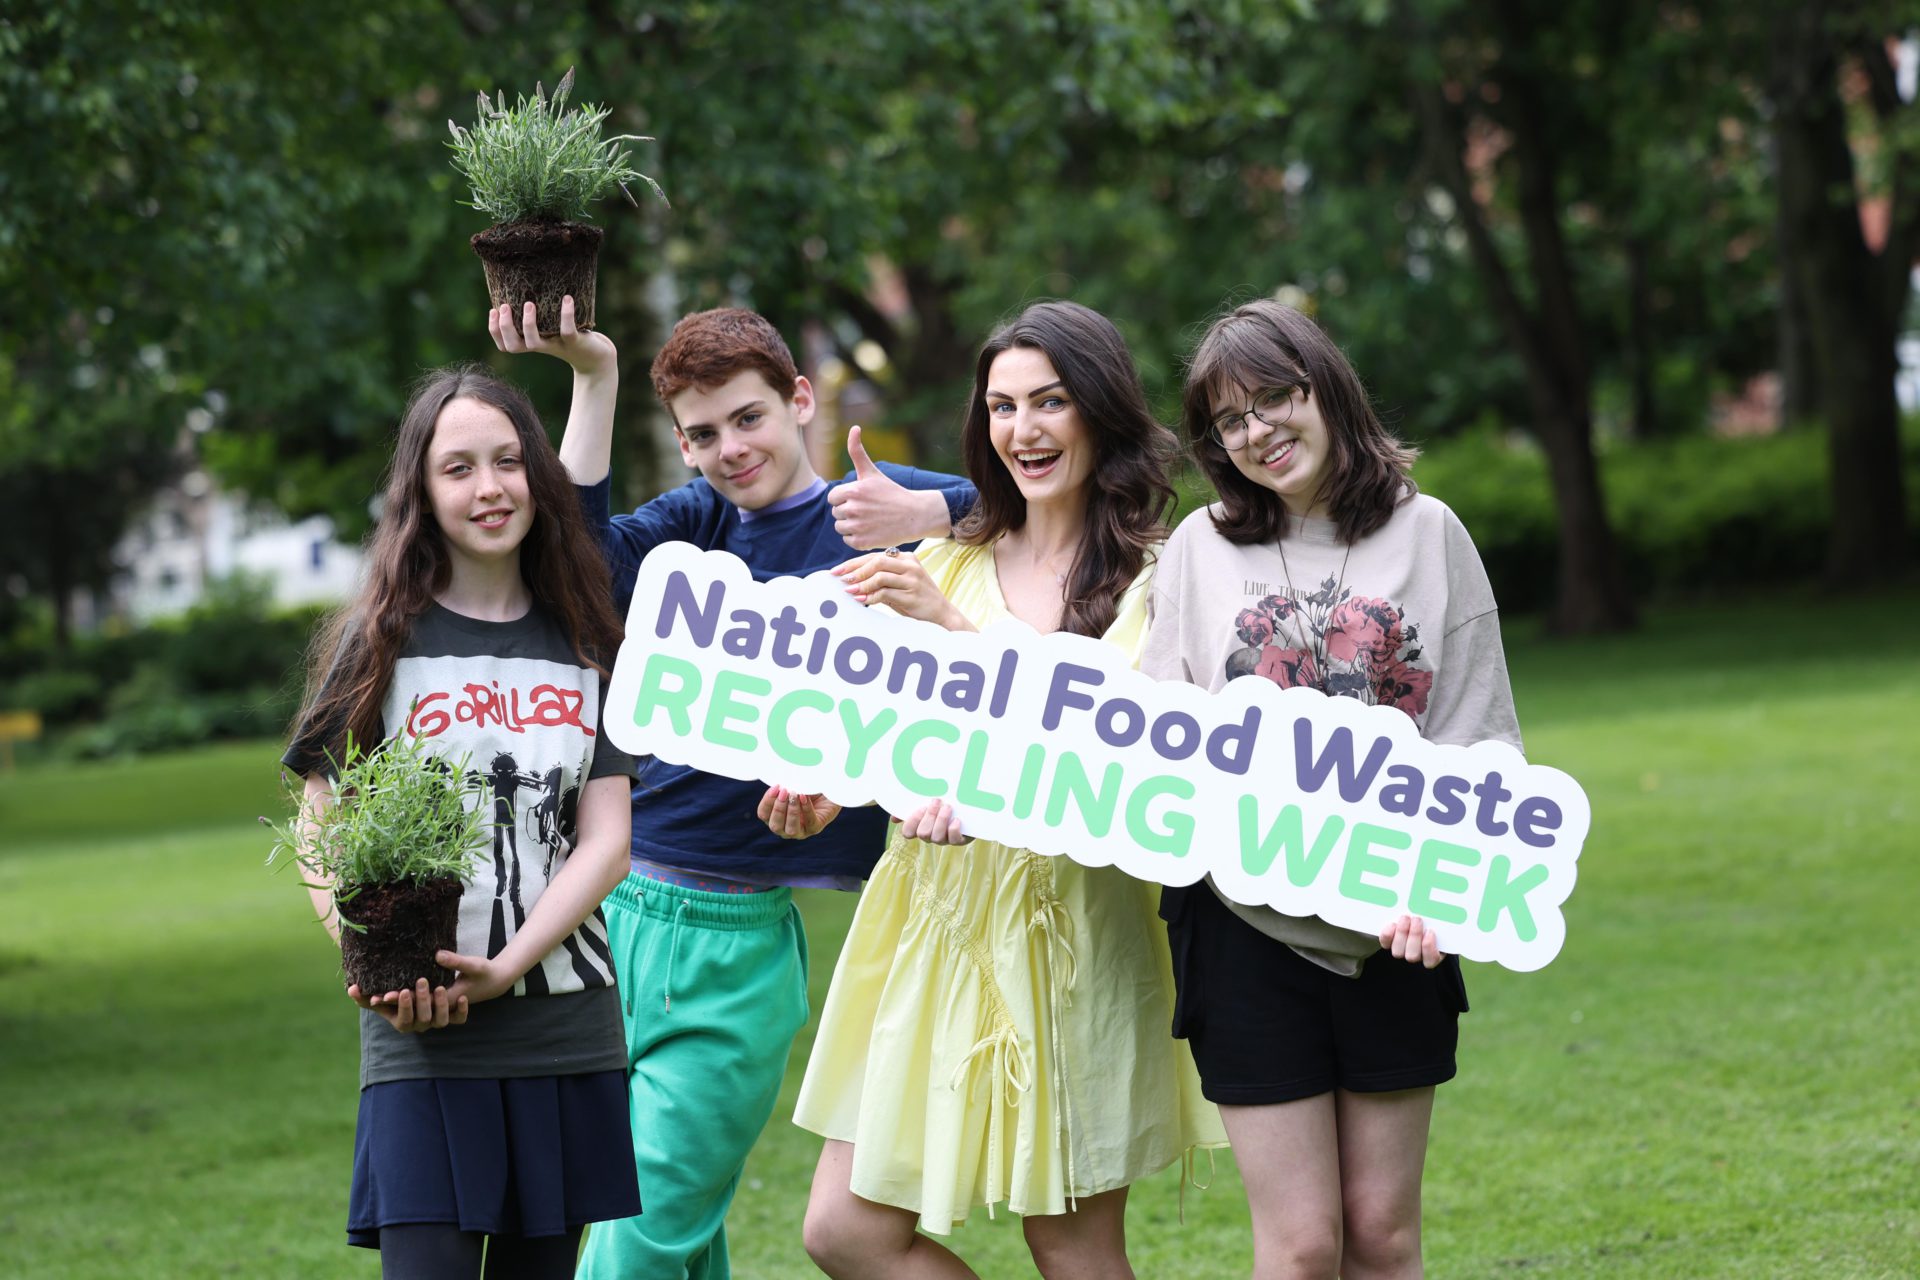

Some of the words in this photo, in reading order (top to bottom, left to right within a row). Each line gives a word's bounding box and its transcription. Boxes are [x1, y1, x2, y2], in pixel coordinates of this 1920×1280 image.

[632, 653, 1196, 857] RECYCLING
[1238, 793, 1550, 943] WEEK
[655, 571, 1018, 719] National
[1042, 661, 1261, 775] Food
[1293, 717, 1563, 848] Waste
